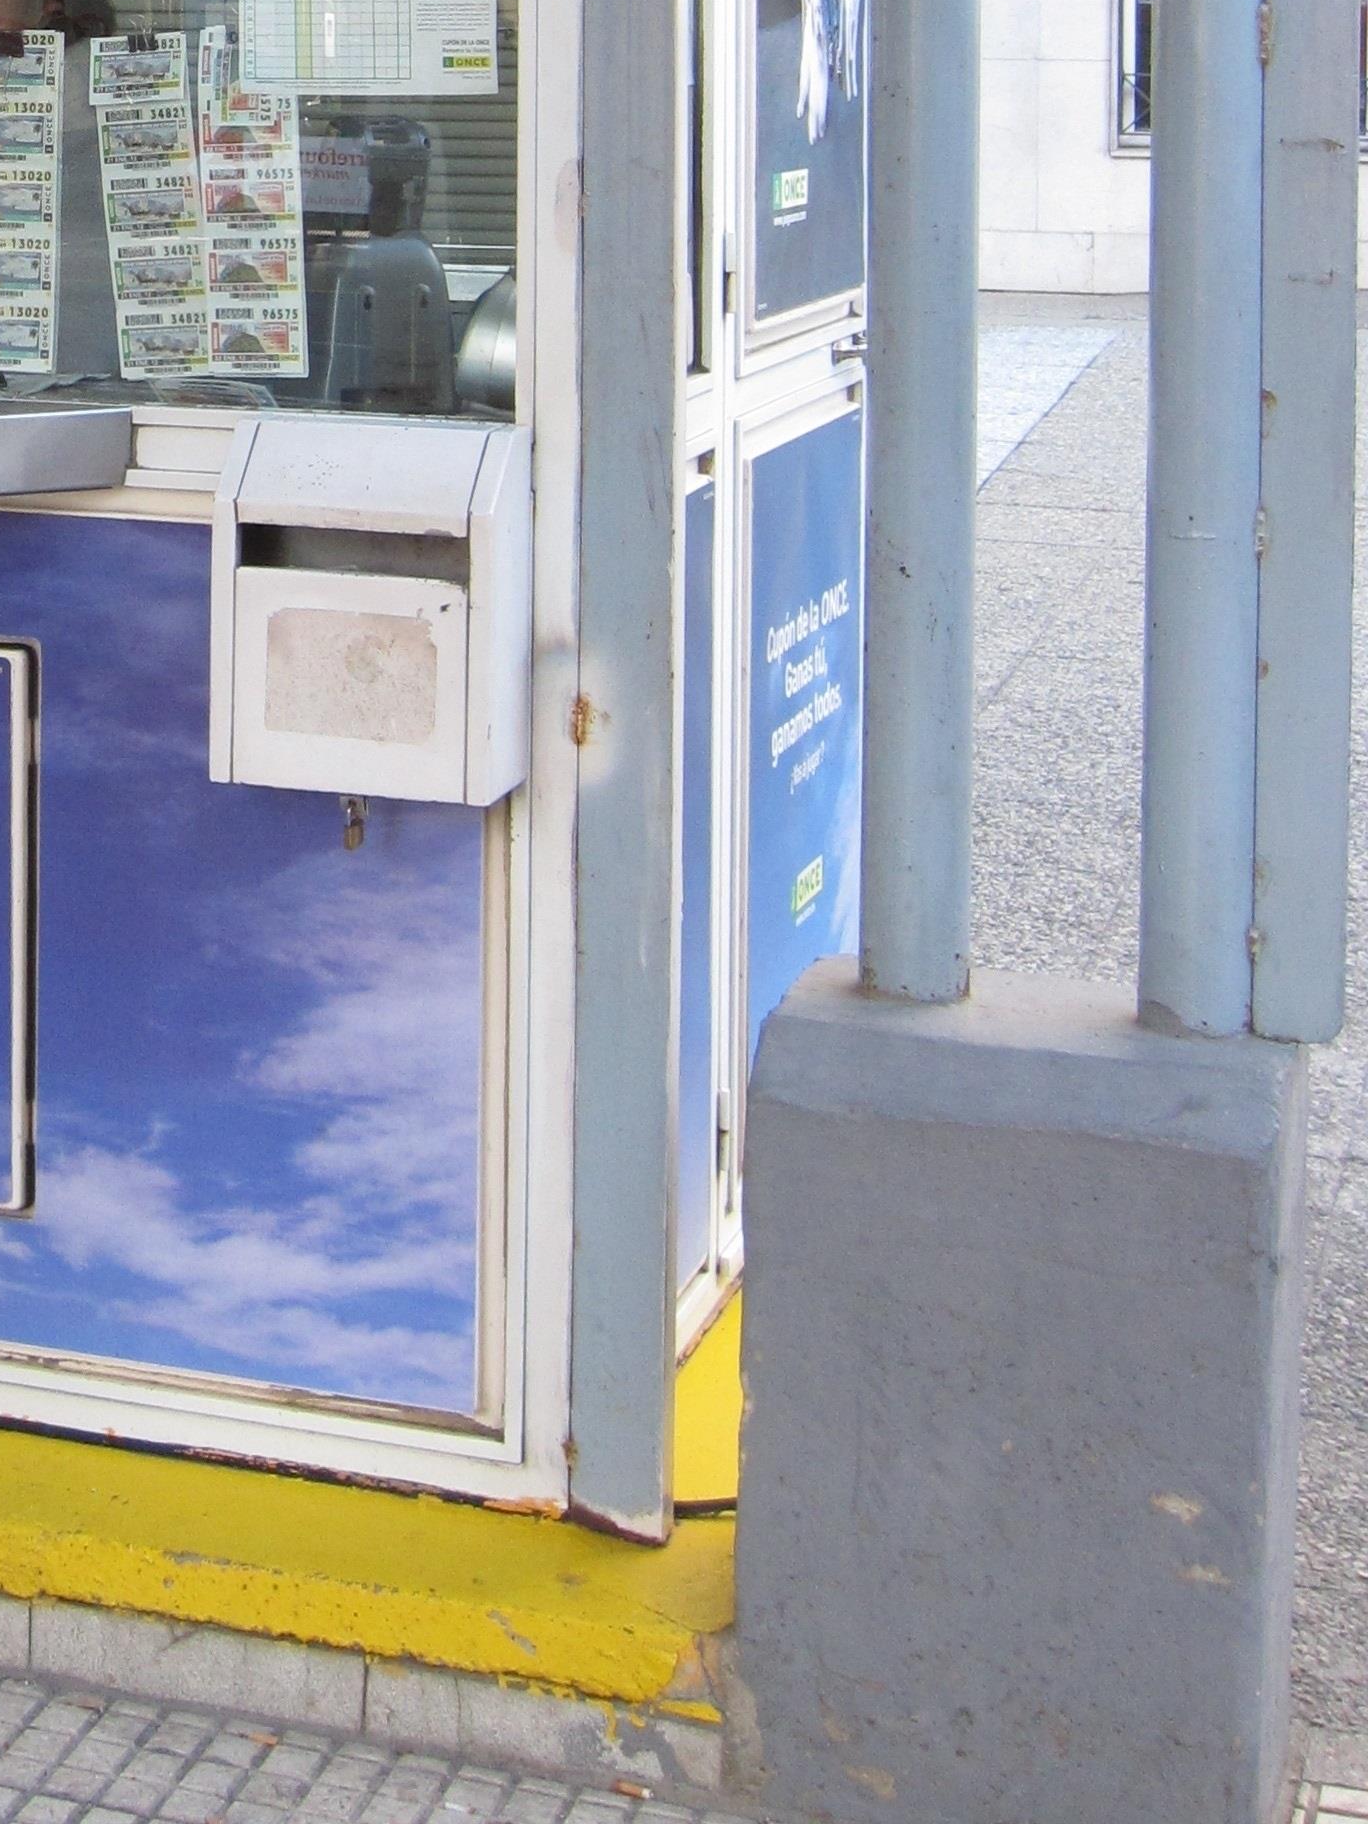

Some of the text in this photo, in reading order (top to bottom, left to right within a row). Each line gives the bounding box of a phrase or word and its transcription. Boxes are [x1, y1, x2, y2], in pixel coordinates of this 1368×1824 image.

[23, 34, 55, 46] 3020
[455, 57, 491, 67] ONCE
[14, 102, 53, 113] 13020
[150, 107, 185, 120] 34821
[12, 171, 52, 181] 13020
[257, 168, 293, 179] 96575
[11, 239, 51, 249] 13020
[260, 239, 297, 250] 96575
[9, 307, 49, 318] 13020
[171, 312, 206, 324] 34821
[262, 308, 298, 319] 96575
[767, 612, 796, 664] Cupón
[796, 606, 809, 642] de
[810, 600, 820, 633] la
[785, 654, 814, 698] Ganas
[771, 702, 814, 768] ganamos
